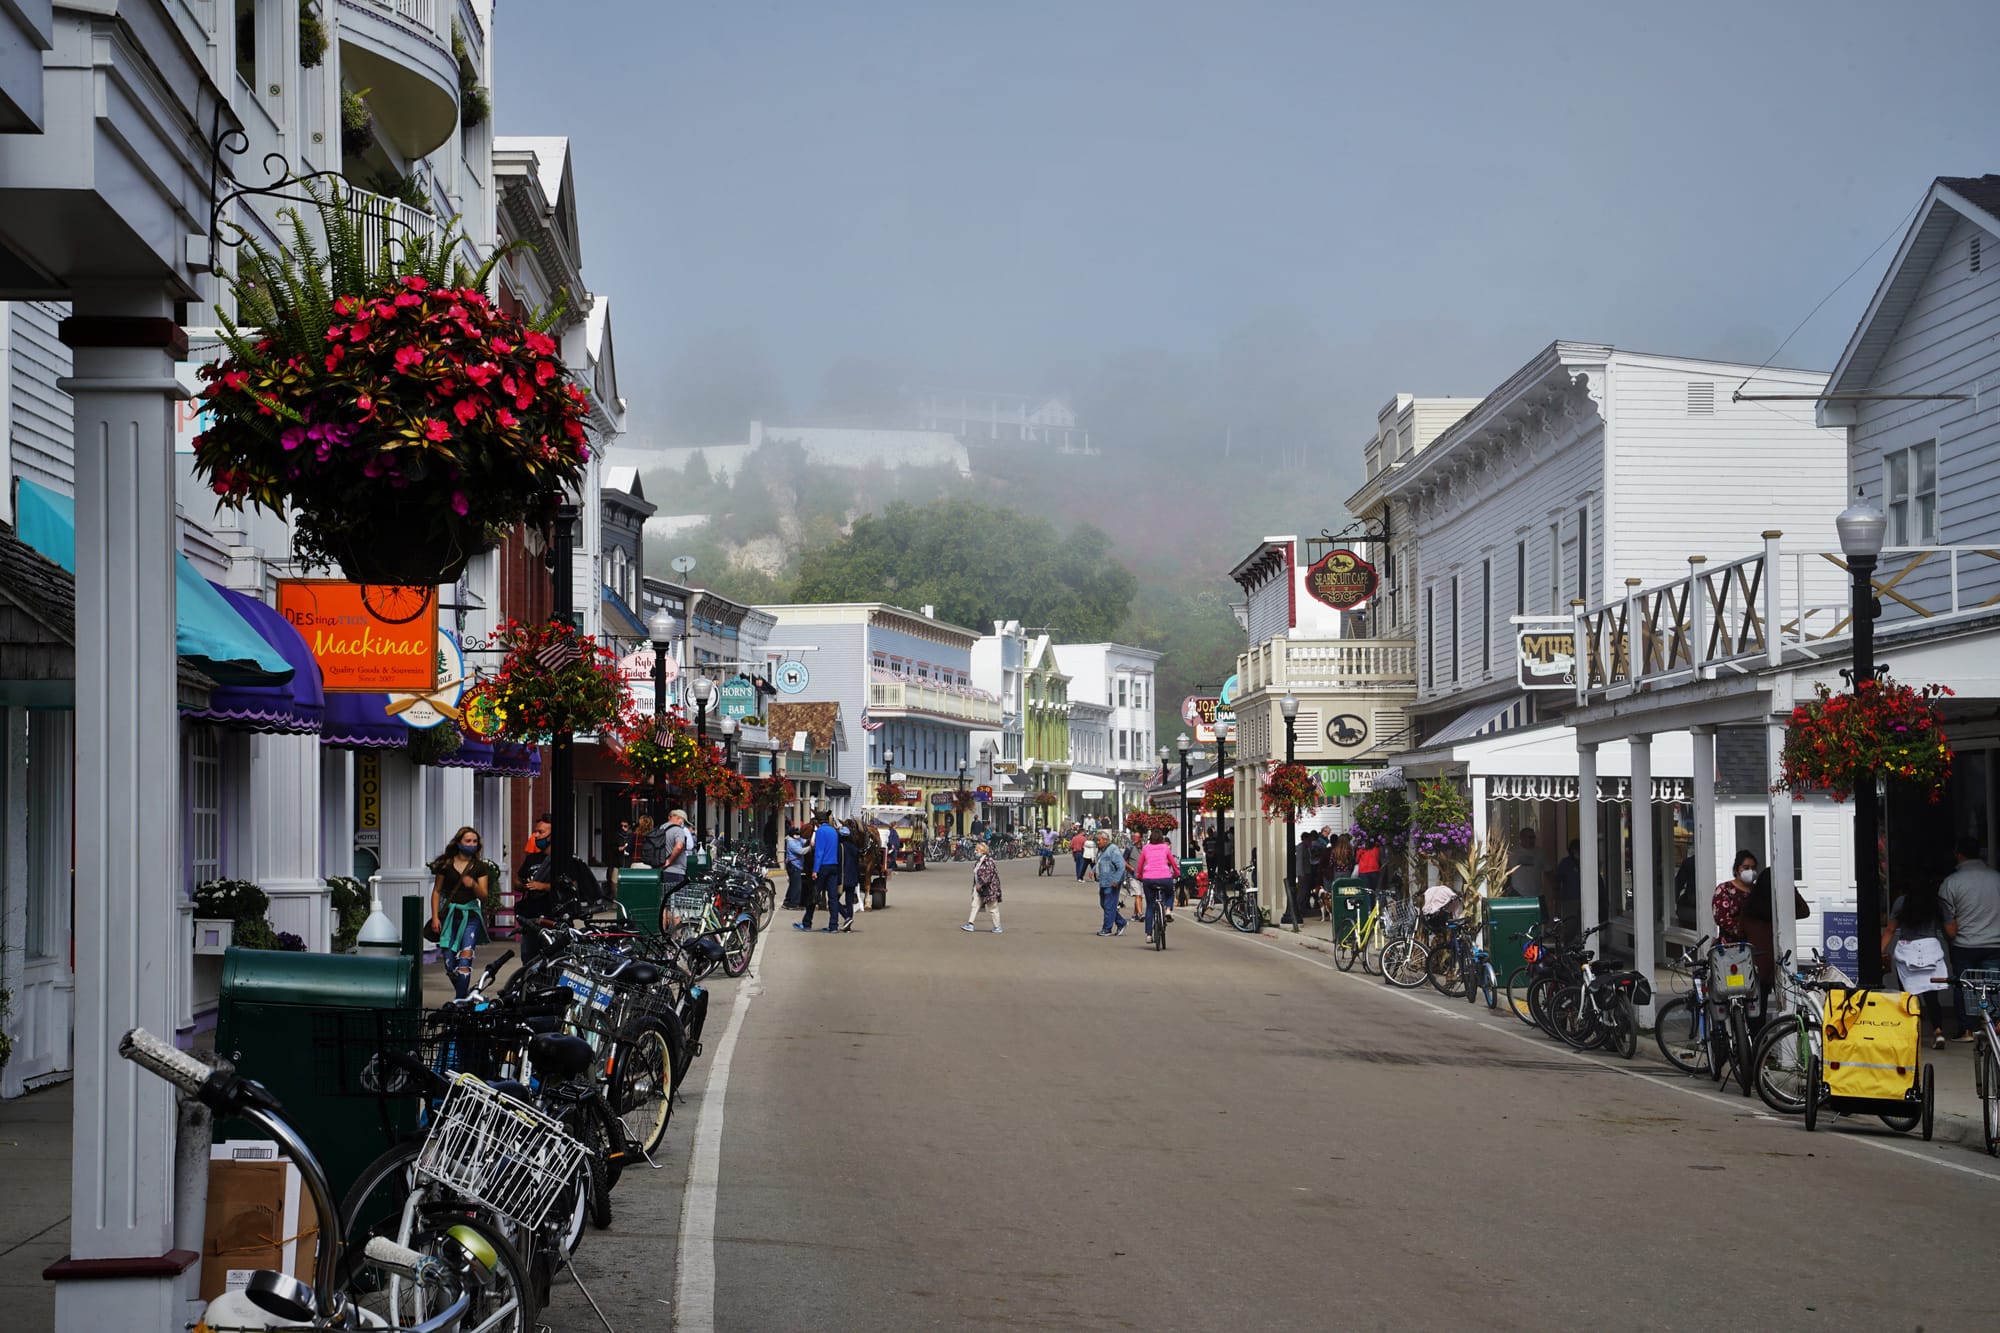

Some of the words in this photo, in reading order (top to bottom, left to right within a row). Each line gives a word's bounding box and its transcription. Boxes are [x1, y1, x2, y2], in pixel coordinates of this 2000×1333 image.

[312, 626, 427, 657] Mackinac
[329, 666, 355, 674] Quality
[358, 666, 379, 674] Goods
[391, 666, 424, 674] Souvenirs
[722, 686, 753, 697] HORN'S
[728, 705, 746, 714] BAR
